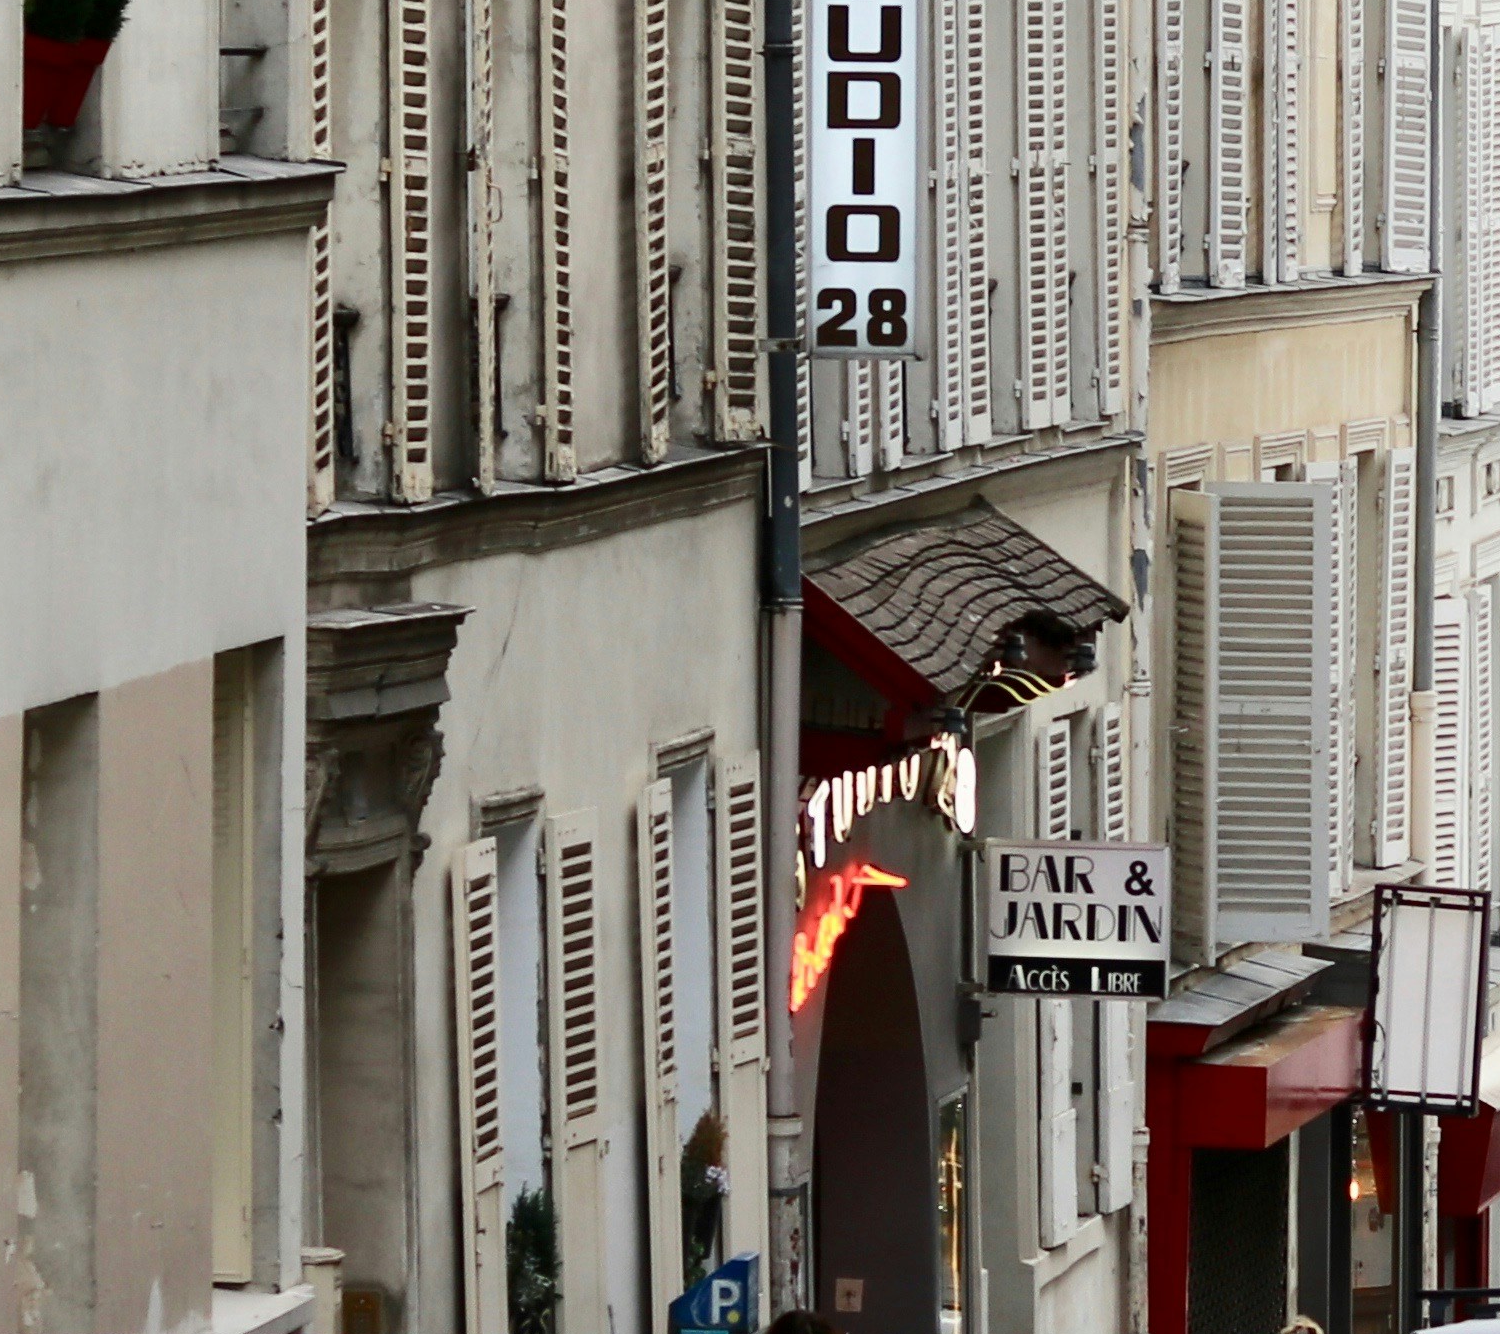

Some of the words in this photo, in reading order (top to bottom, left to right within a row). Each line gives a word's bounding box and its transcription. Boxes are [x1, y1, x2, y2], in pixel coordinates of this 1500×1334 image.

[815, 287, 908, 350] 28
[1000, 854, 1094, 894] BAR
[1125, 860, 1156, 896] &
[990, 901, 1163, 943] JARDIN
[711, 1278, 742, 1326] P
